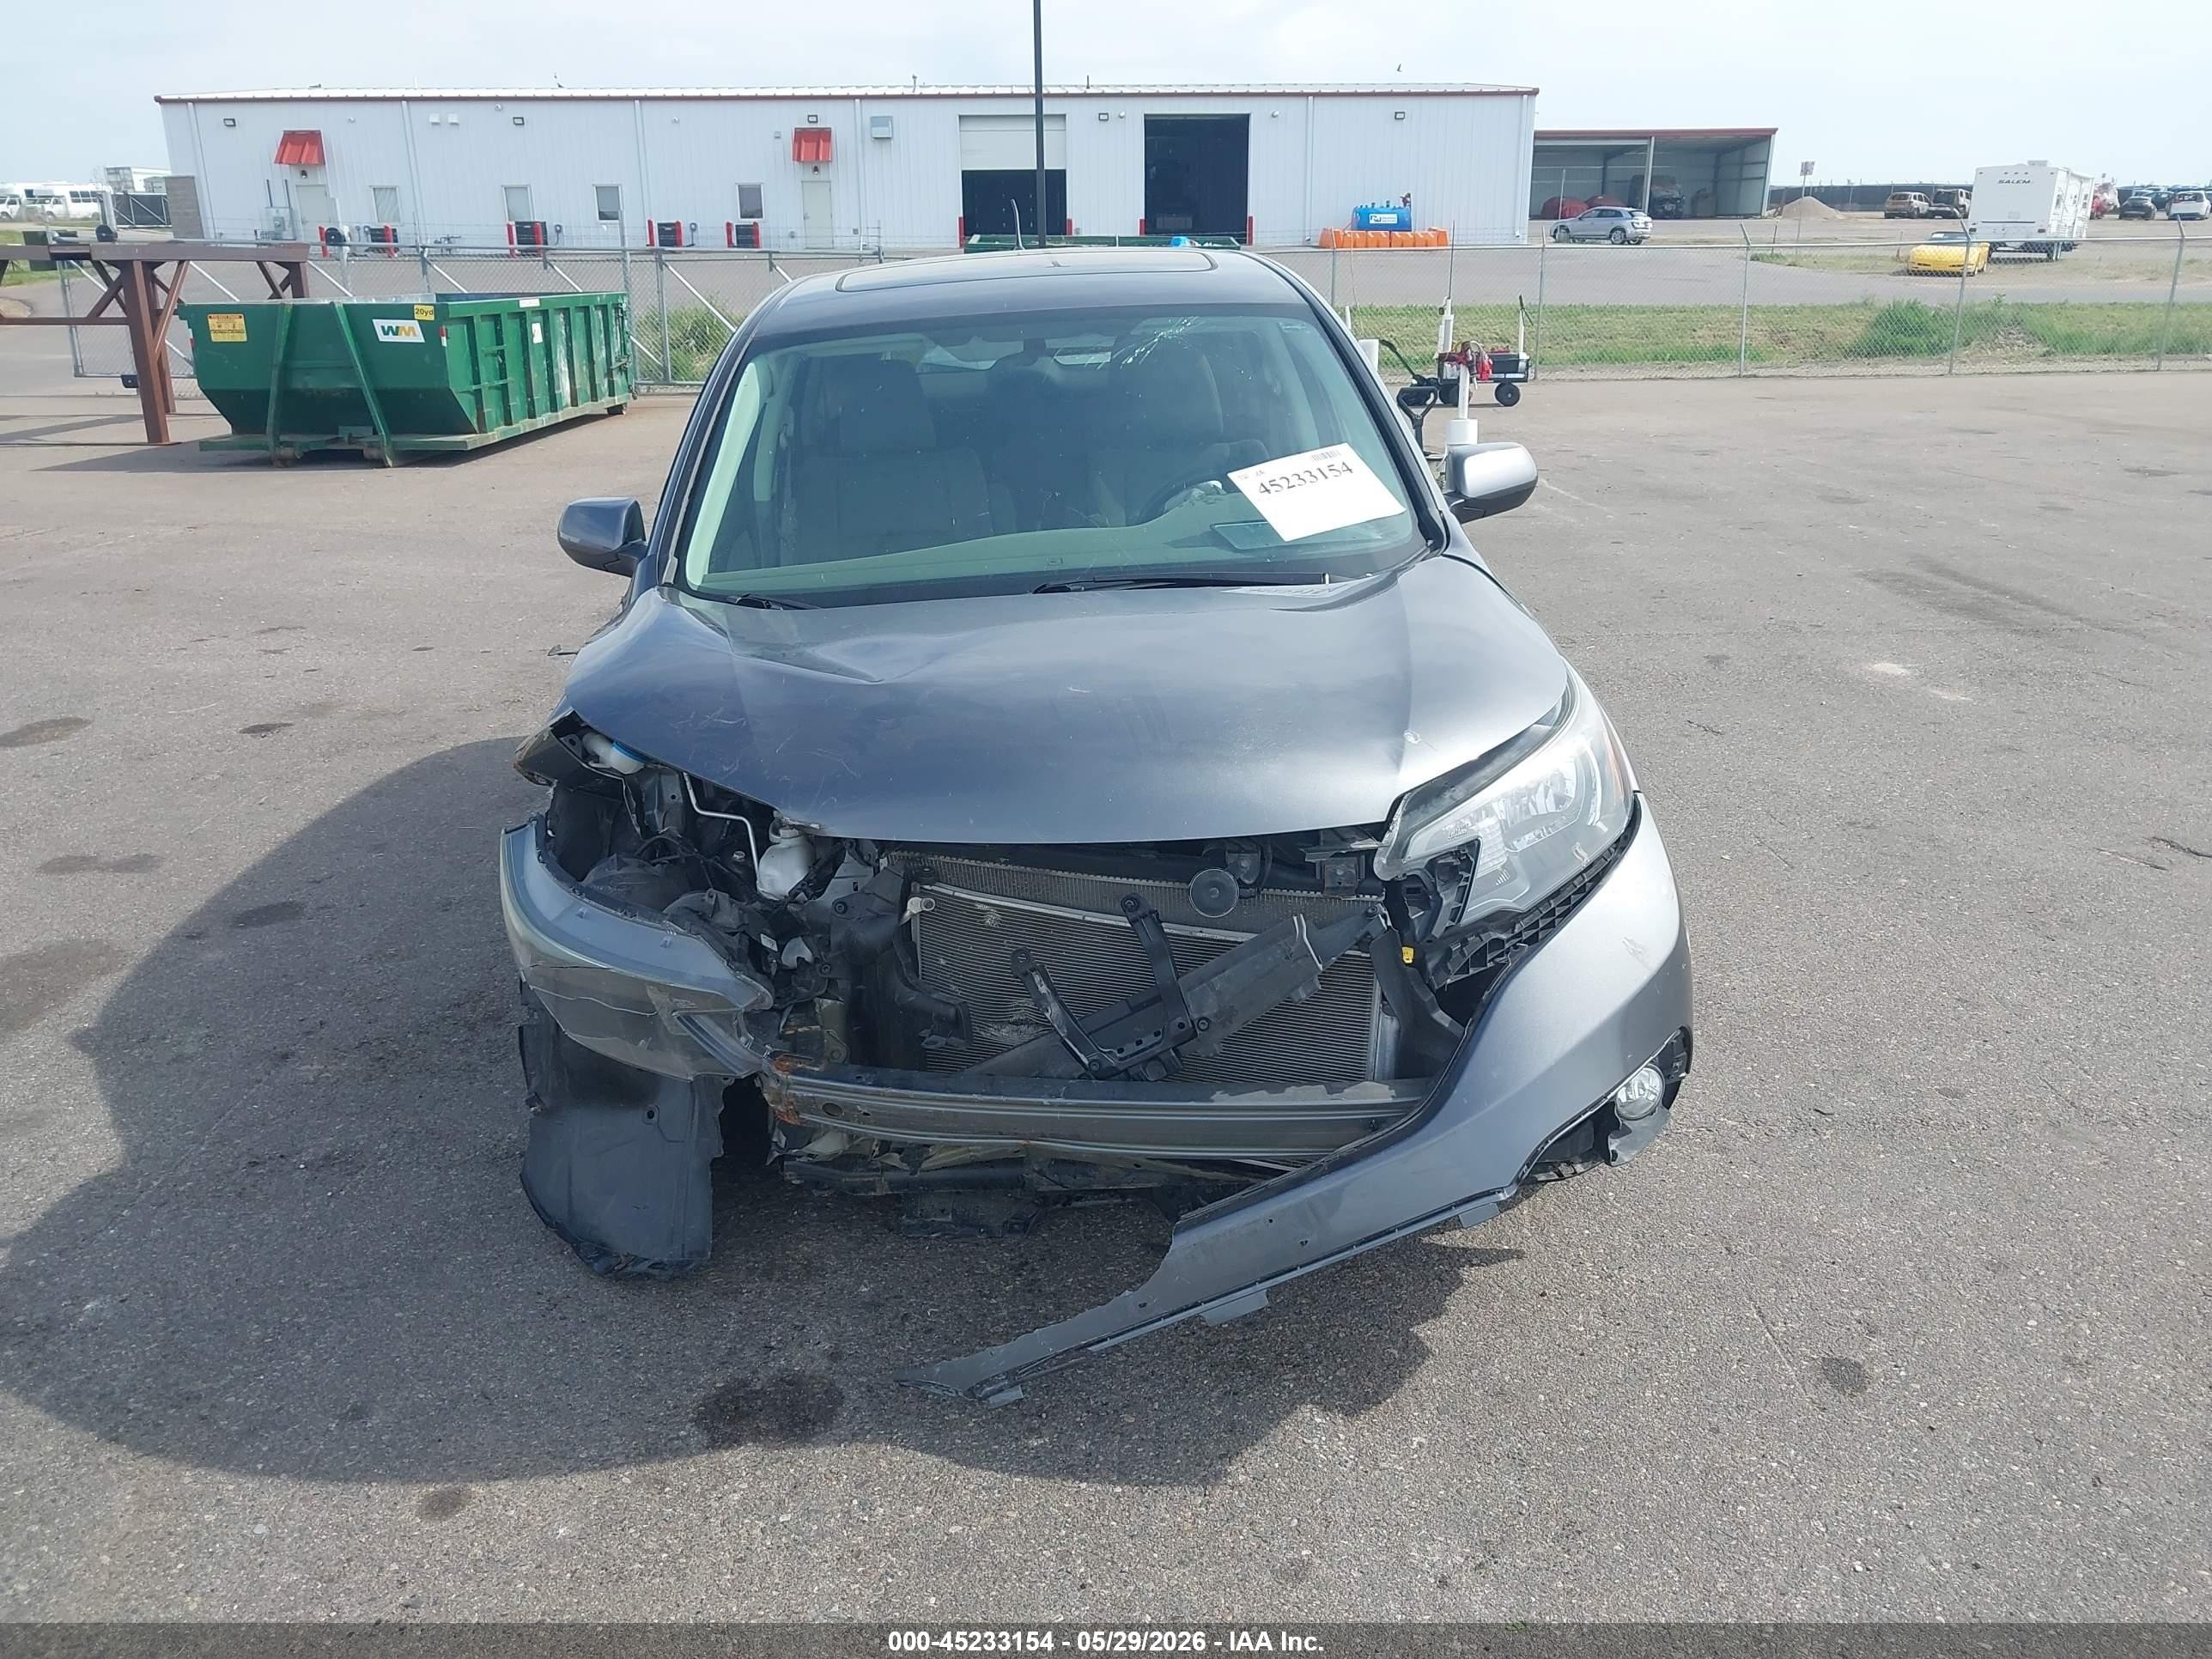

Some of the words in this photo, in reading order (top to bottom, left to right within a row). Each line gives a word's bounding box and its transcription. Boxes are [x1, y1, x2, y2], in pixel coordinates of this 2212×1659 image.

[415, 307, 434, 317] 20yd
[380, 325, 418, 337] WM
[1259, 461, 1354, 494] 45233154
